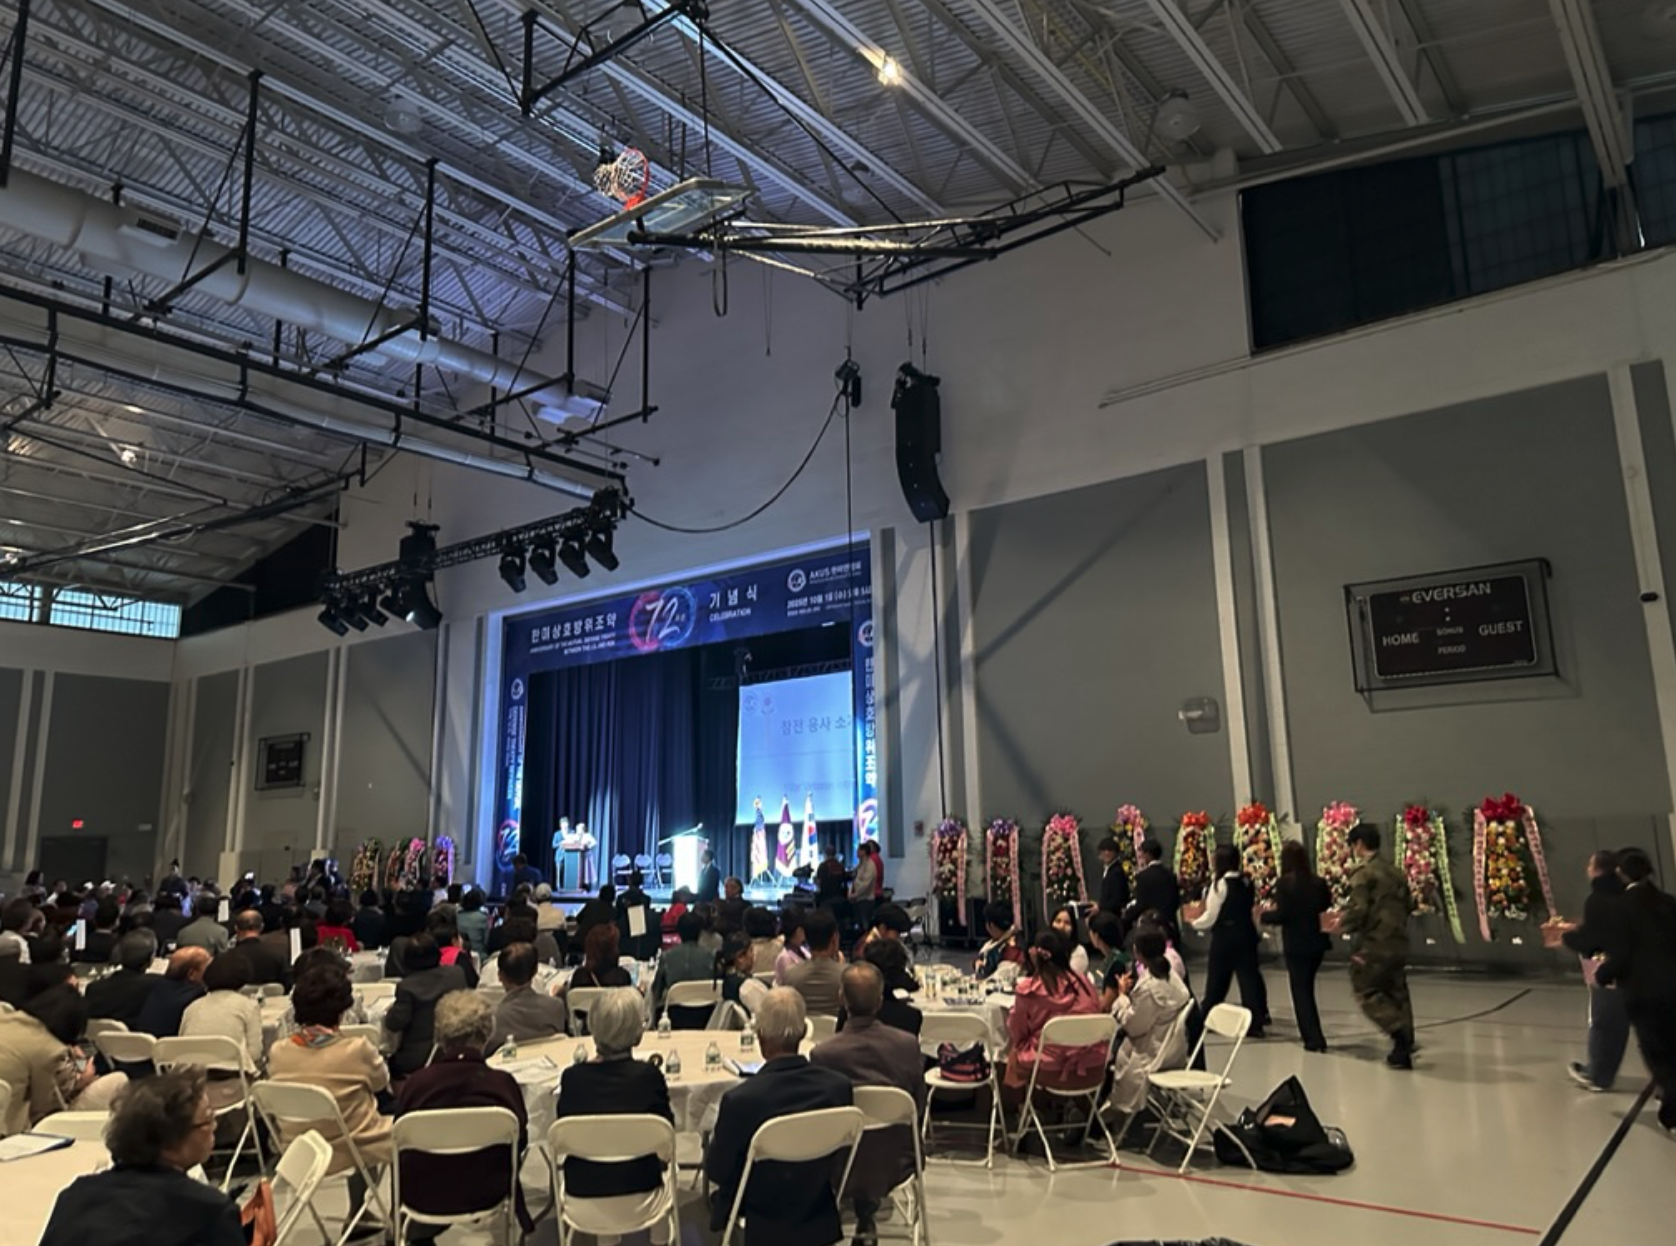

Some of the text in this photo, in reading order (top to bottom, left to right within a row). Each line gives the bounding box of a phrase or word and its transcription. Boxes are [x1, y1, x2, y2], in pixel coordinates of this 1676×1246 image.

[1412, 583, 1491, 604] EVERSAN
[530, 612, 618, 644] 한미상호방위조약
[645, 597, 681, 644] 72
[1478, 620, 1524, 637] GUEST
[1382, 632, 1419, 647] HOME
[1437, 644, 1466, 655] PERIOD
[808, 716, 831, 733] 용사
